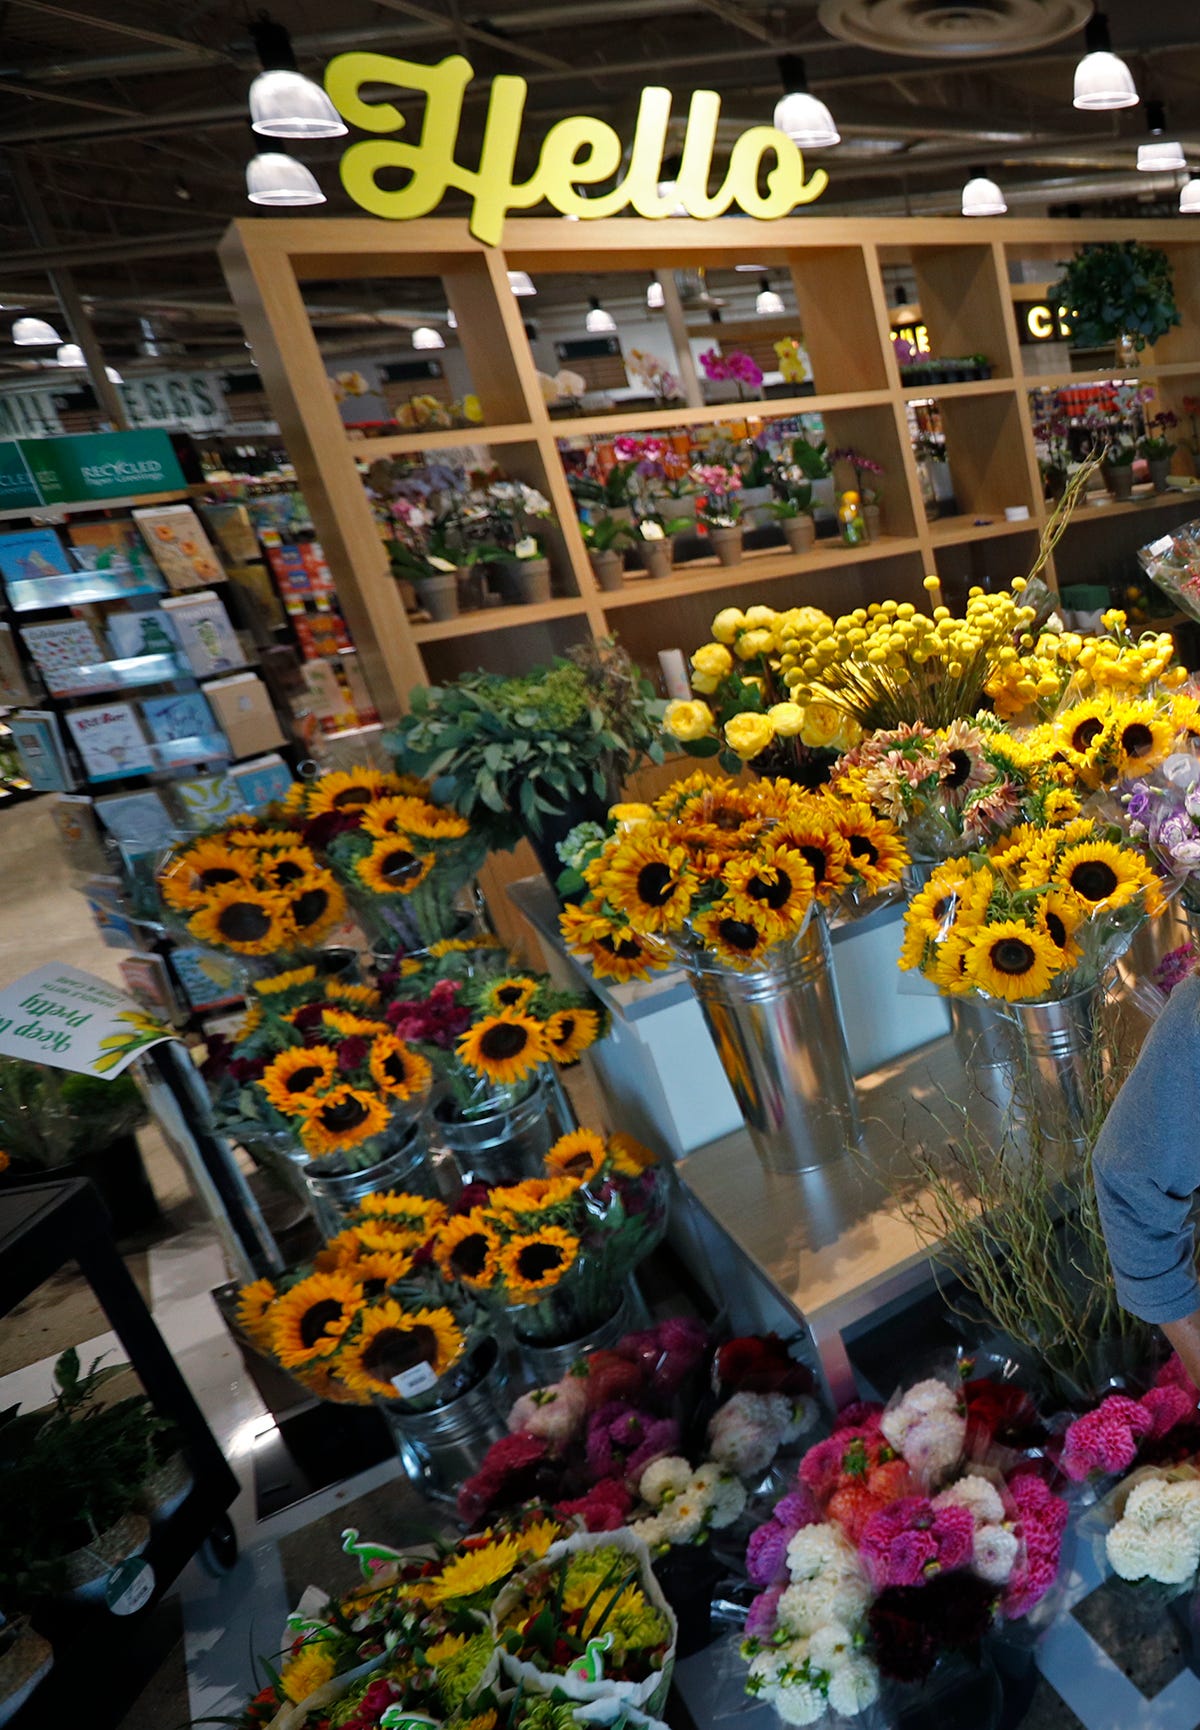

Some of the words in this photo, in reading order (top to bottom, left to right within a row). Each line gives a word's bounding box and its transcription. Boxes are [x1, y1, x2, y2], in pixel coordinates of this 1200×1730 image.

[324, 52, 829, 247] Hello
[121, 379, 216, 424] EGGS
[80, 460, 162, 478] RECYCLED
[18, 993, 93, 1028] Pretty
[13, 1020, 73, 1054] Keep
